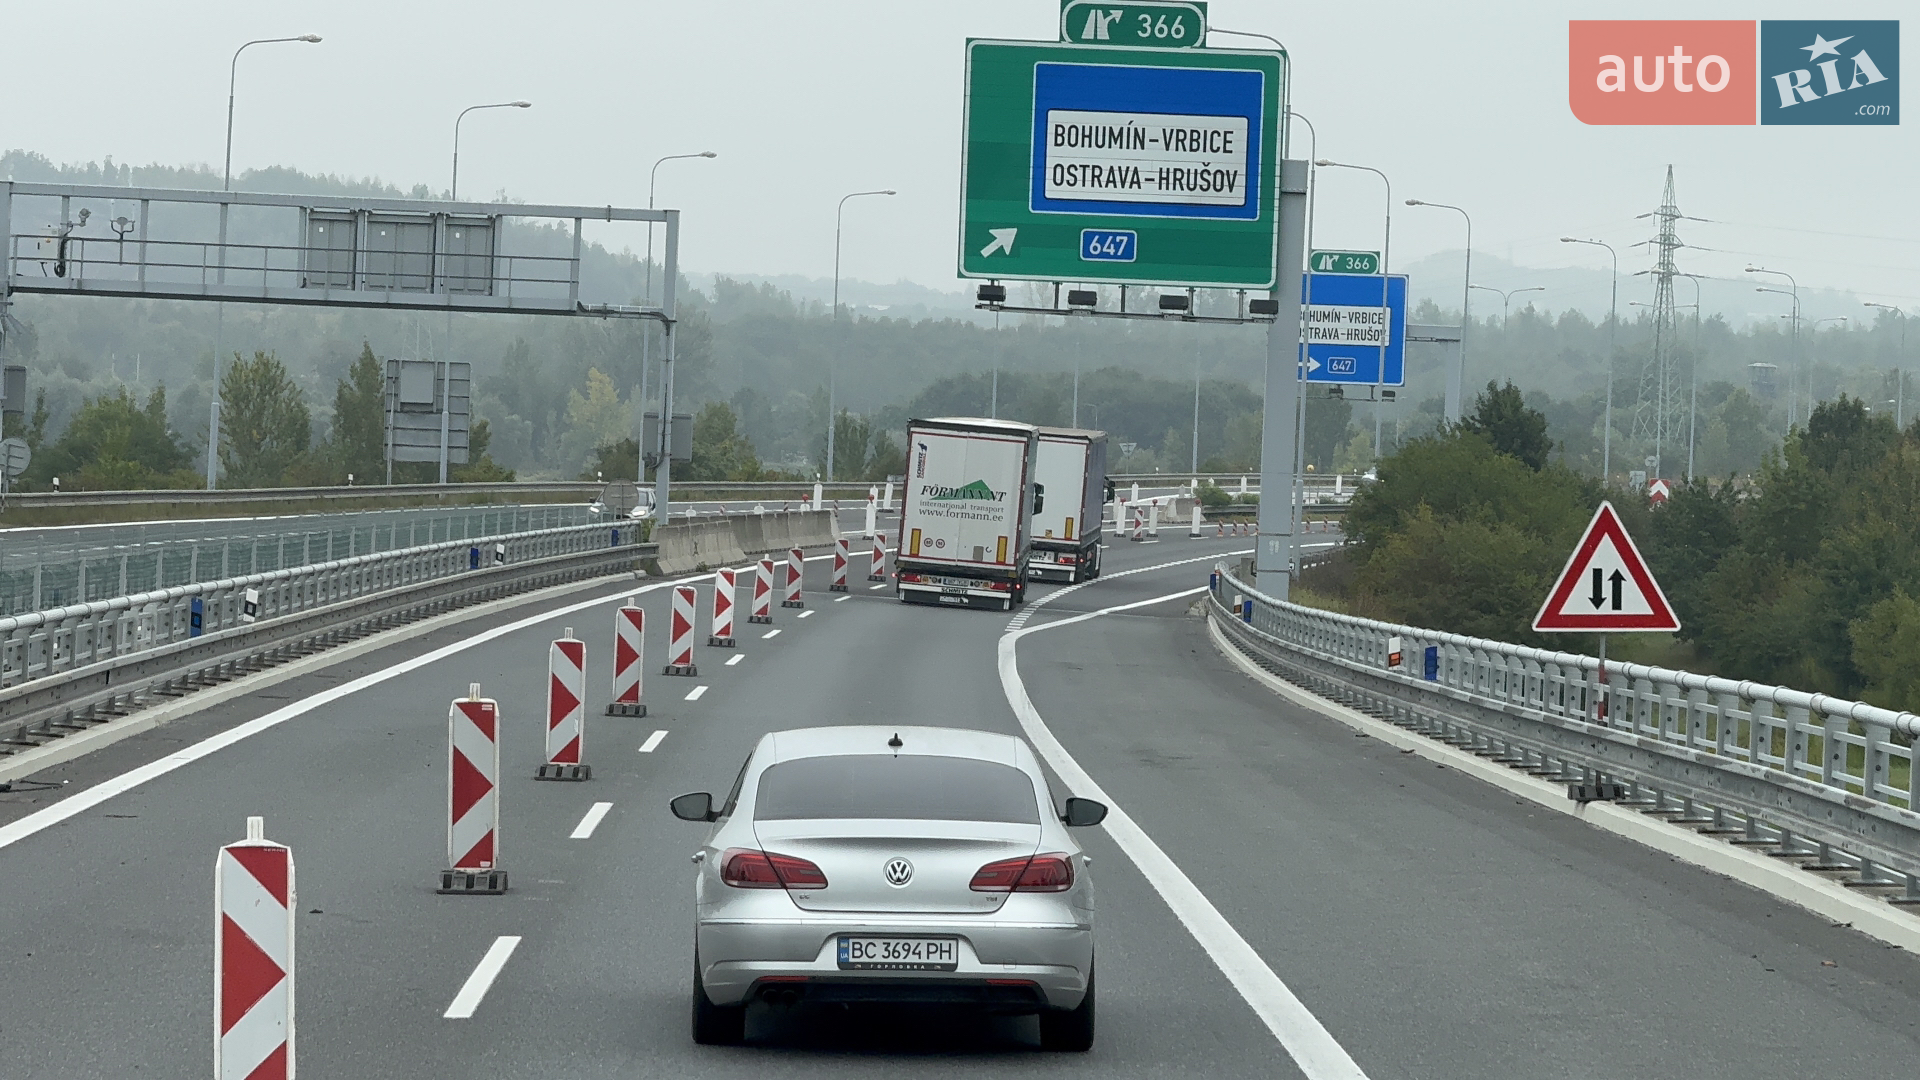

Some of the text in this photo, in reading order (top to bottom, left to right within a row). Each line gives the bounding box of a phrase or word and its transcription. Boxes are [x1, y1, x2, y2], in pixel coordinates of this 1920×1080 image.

[1137, 14, 1186, 39] 366
[1089, 235, 1129, 257] 647
[1346, 257, 1370, 270] 366
[1331, 360, 1352, 371] 647
[919, 500, 1004, 514] international transport
[918, 508, 1004, 522] www.formann.ee
[851, 942, 952, 960] BC 3694 PH
